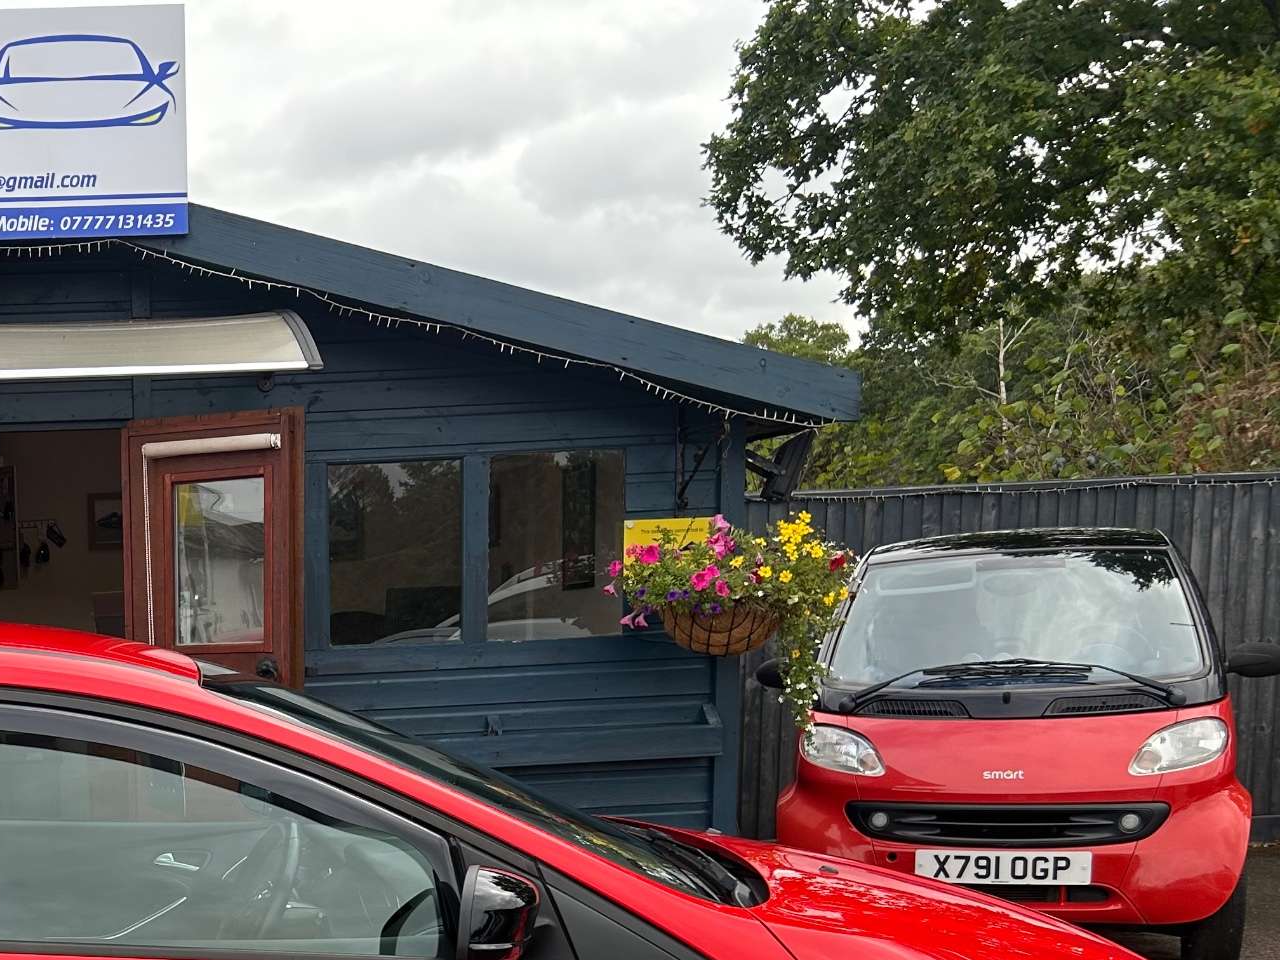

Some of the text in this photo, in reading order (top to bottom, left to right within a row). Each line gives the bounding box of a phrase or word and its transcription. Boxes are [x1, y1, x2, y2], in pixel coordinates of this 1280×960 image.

[59, 213, 176, 231] 07777131435
[982, 769, 1025, 780] smart
[933, 854, 1071, 881] X791 OGP
